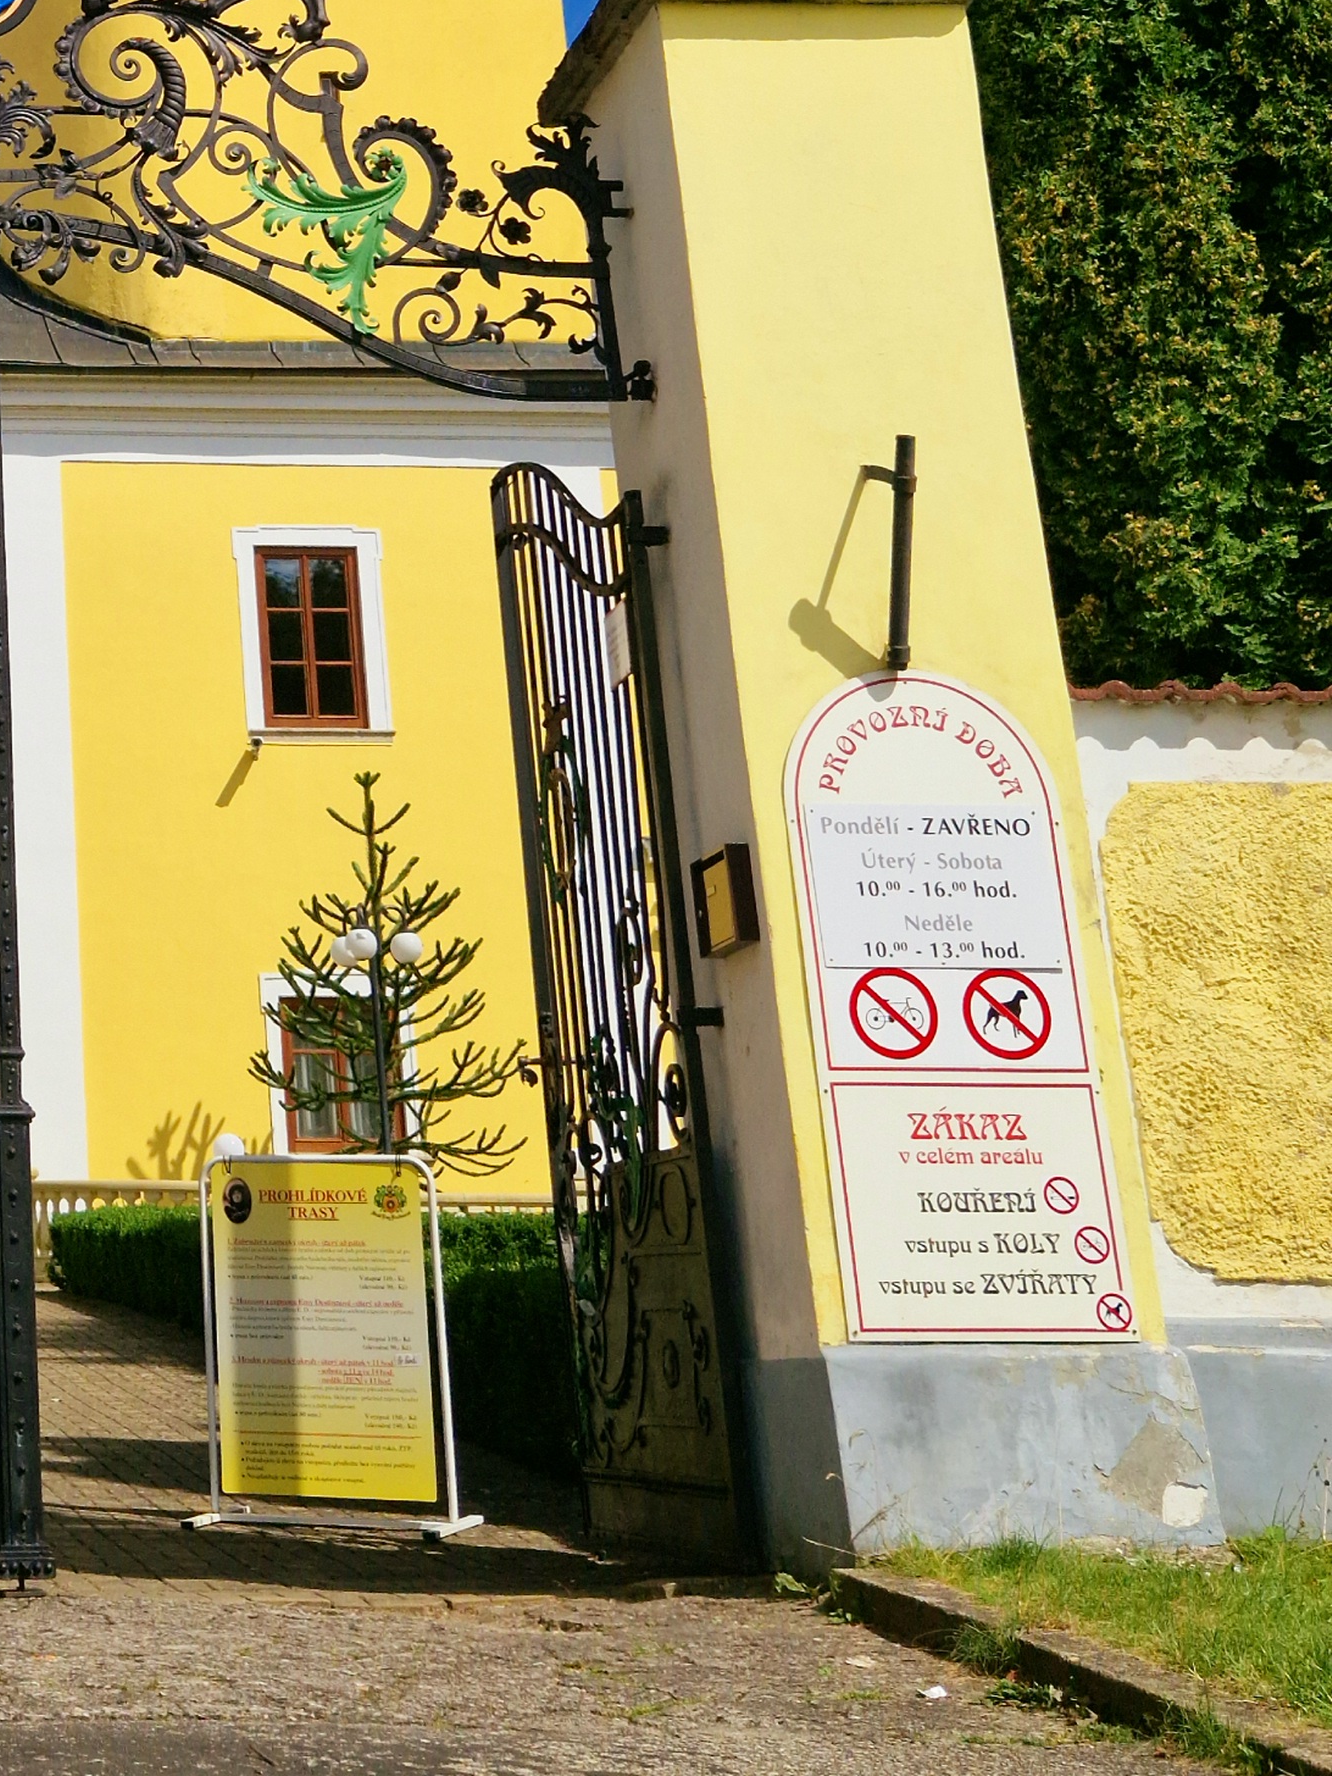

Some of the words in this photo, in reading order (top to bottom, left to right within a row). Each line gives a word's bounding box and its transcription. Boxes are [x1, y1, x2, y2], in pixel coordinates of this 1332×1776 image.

[819, 705, 948, 794] PROVOZNÍ
[955, 721, 1024, 798] DOBA
[821, 816, 899, 834] Pondělí
[922, 814, 1031, 836] ZAVŘENO
[861, 848, 915, 874] Úterý
[937, 852, 1002, 869] Sobota
[857, 881, 900, 896] 10.00
[923, 882, 966, 897] 16.00
[973, 880, 1016, 898] hod.
[905, 914, 972, 931] Neděle
[864, 941, 908, 957] 10.00
[930, 942, 974, 958] 13.00
[981, 941, 1025, 958] hod.
[907, 1107, 1027, 1140] ZÁKAZ
[899, 1152, 910, 1164] v
[916, 1148, 974, 1164] celém
[980, 1148, 1043, 1164] areálu
[258, 1187, 367, 1203] PROHLÍDKOVÉ
[917, 1188, 1036, 1213] KOUŘENÍ
[287, 1206, 339, 1219] TRASY
[904, 1238, 972, 1257] vstupu
[978, 1241, 989, 1253] s
[994, 1233, 1060, 1254] KOLY
[879, 1279, 946, 1298] vstupu
[953, 1281, 976, 1294] se
[980, 1269, 1097, 1294] ZVÍŘATY
